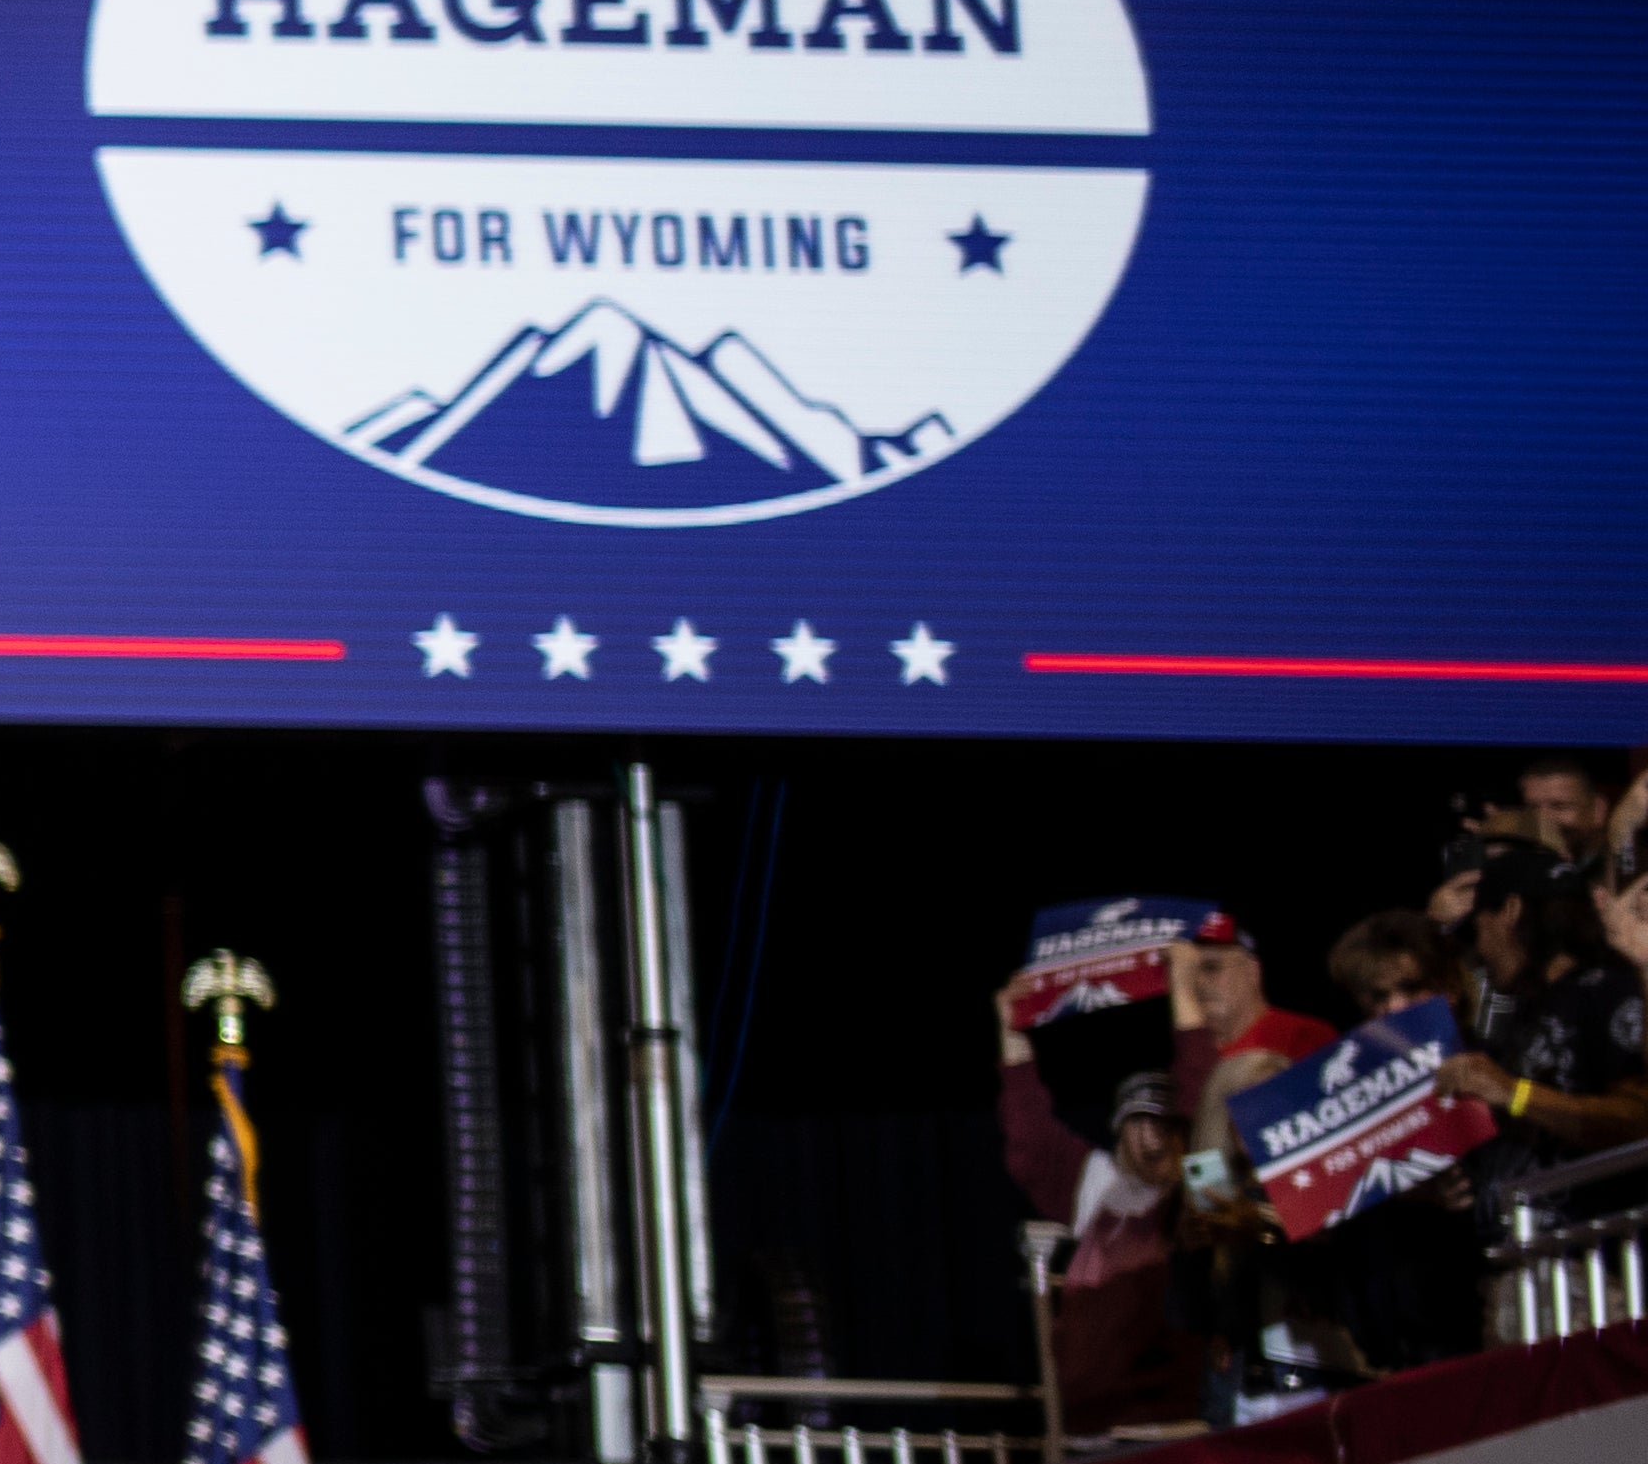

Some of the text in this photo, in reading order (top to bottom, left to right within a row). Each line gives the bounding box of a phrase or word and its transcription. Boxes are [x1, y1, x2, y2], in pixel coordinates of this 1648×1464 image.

[393, 207, 871, 274] FOR WYOMING
[1258, 1039, 1444, 1158] HAGEMAN
